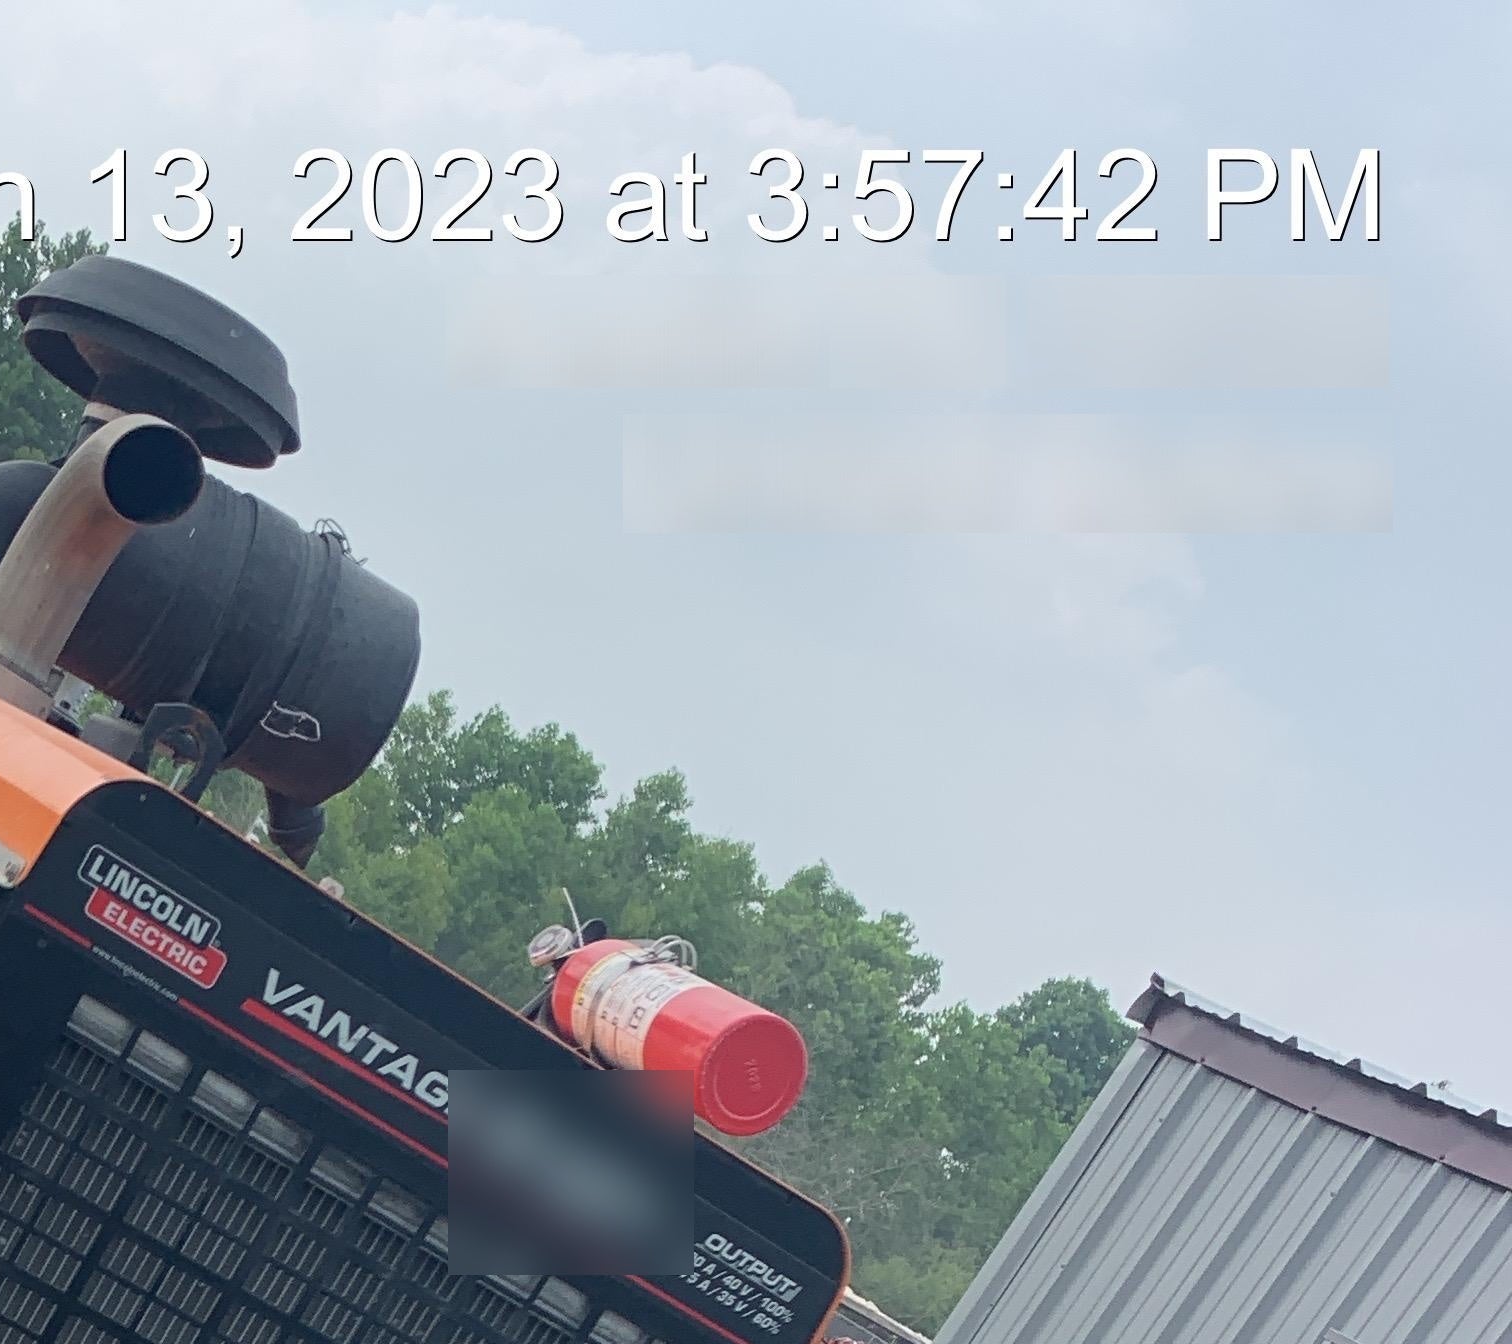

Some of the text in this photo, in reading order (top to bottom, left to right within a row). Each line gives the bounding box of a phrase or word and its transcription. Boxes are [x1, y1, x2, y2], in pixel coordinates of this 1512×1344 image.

[88, 854, 211, 945] LINCOLN
[102, 901, 209, 976] ELECTRIC
[262, 966, 449, 1116] VANTAG
[700, 1262, 717, 1276] A
[722, 1274, 744, 1291] 40
[740, 1284, 755, 1297] V
[759, 1297, 795, 1324] 100%
[704, 1232, 798, 1292] OUTPUT
[715, 1290, 738, 1307] 35
[752, 1312, 782, 1335] 60%
